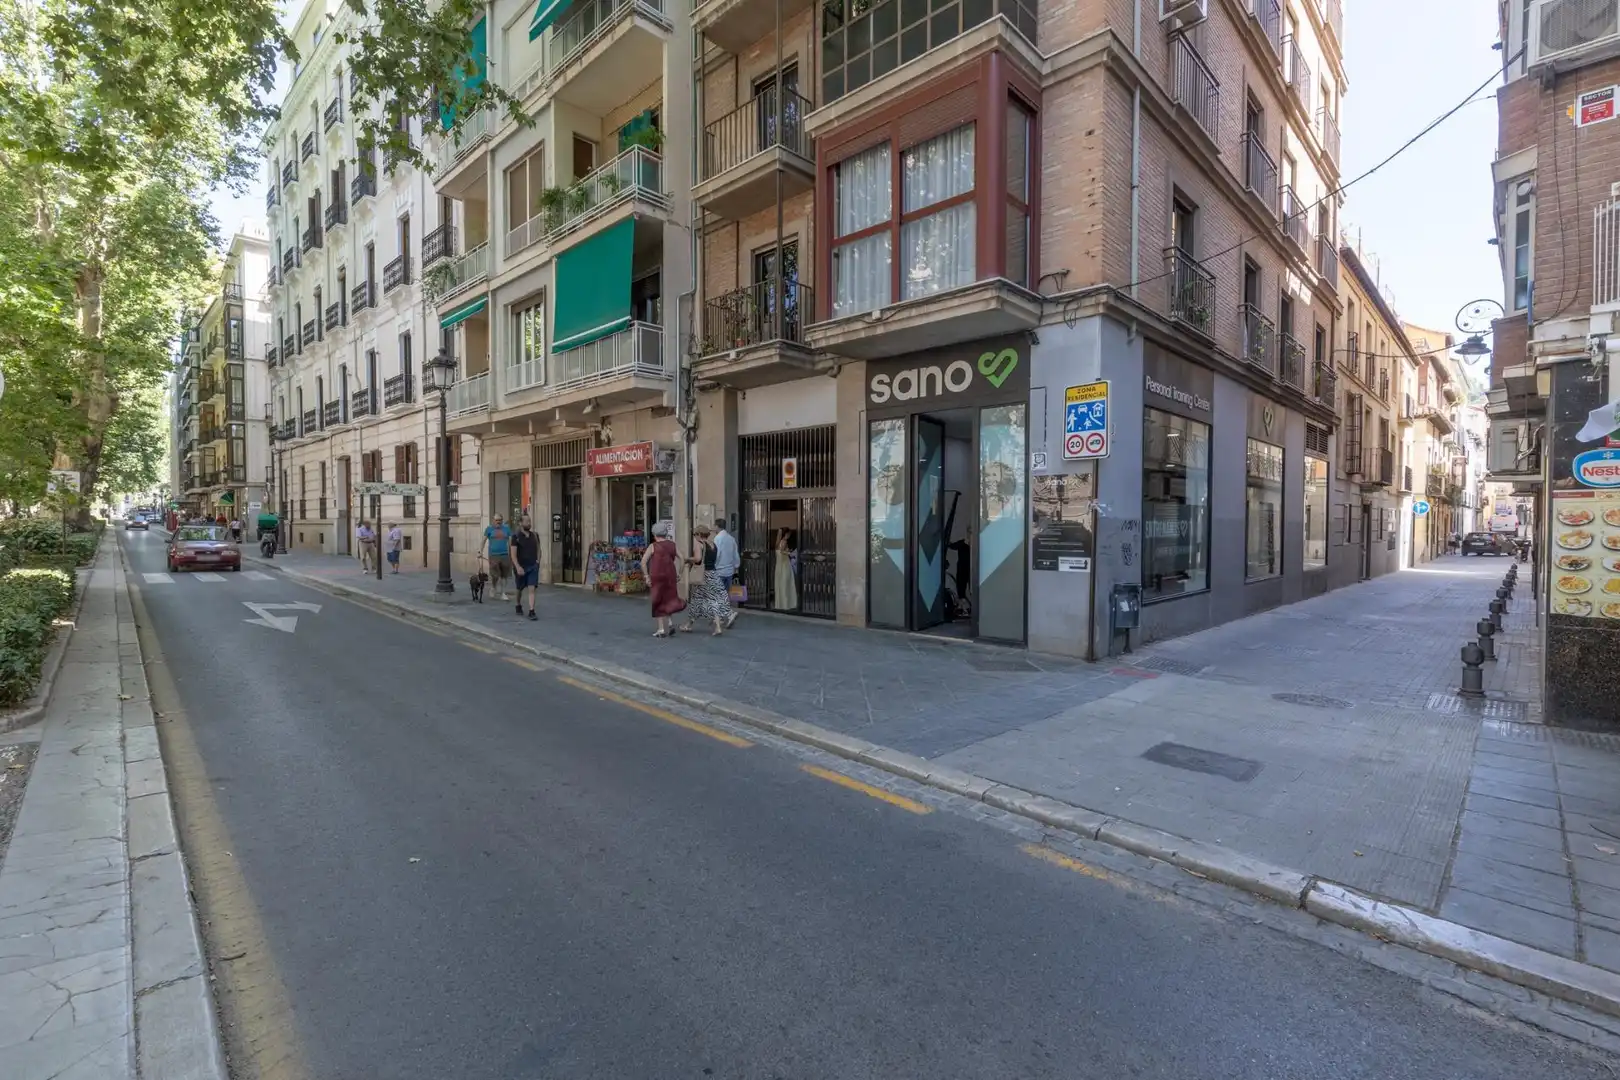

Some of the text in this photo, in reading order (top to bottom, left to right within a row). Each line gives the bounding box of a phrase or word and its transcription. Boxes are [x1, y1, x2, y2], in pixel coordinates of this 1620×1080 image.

[870, 360, 973, 403] sano
[1068, 391, 1106, 401] RESIDENCIAL
[1077, 386, 1096, 394] ZONA
[1145, 375, 1172, 398] Personal
[1172, 386, 1193, 409] Training
[1070, 441, 1081, 449] 20
[595, 446, 643, 465] ALIMENTACIÓN
